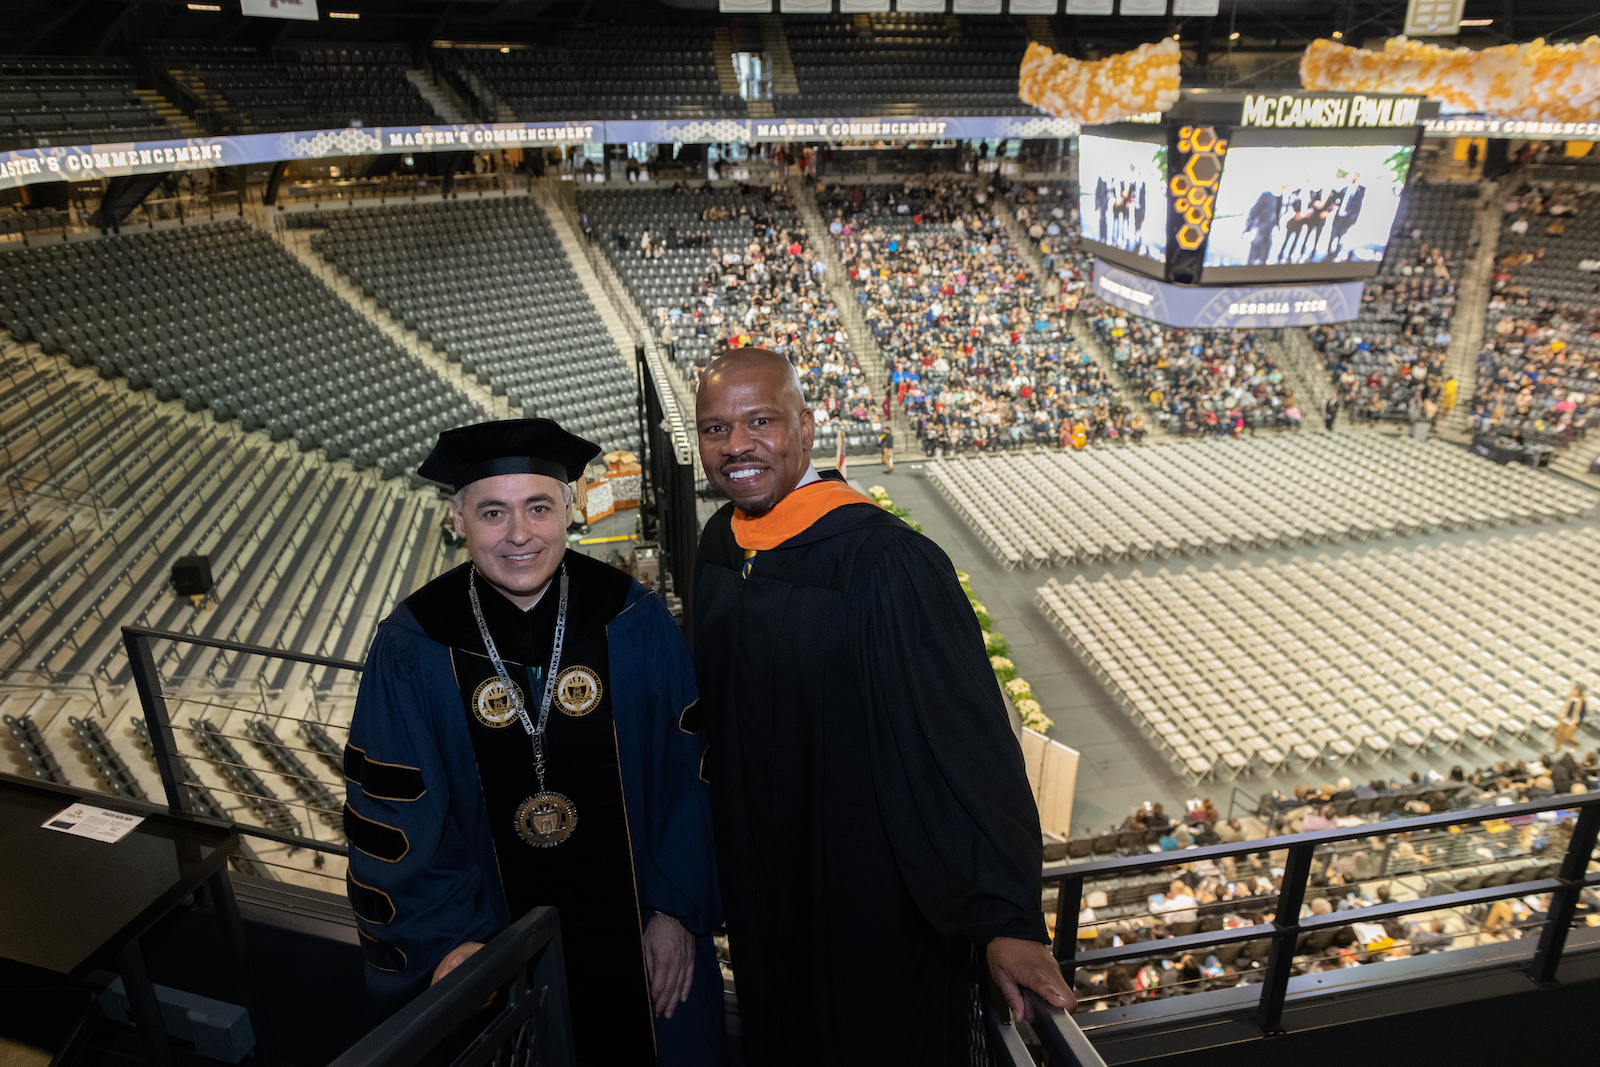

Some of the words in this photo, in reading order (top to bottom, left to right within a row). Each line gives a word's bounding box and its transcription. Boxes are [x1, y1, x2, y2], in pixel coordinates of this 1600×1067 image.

[1349, 94, 1420, 127] PAVILION
[388, 130, 469, 147] MASTER'S
[474, 126, 594, 143] COMMENCEMENT
[756, 123, 827, 137] MASTER'S
[832, 121, 947, 135] COMMENCEMENT
[1503, 120, 1600, 136] COMMENCE
[0, 155, 60, 180] ASTER'S
[67, 144, 223, 171] COMMENCEMENT
[1228, 302, 1290, 316] GEORGIA
[1294, 299, 1328, 314] TECH
